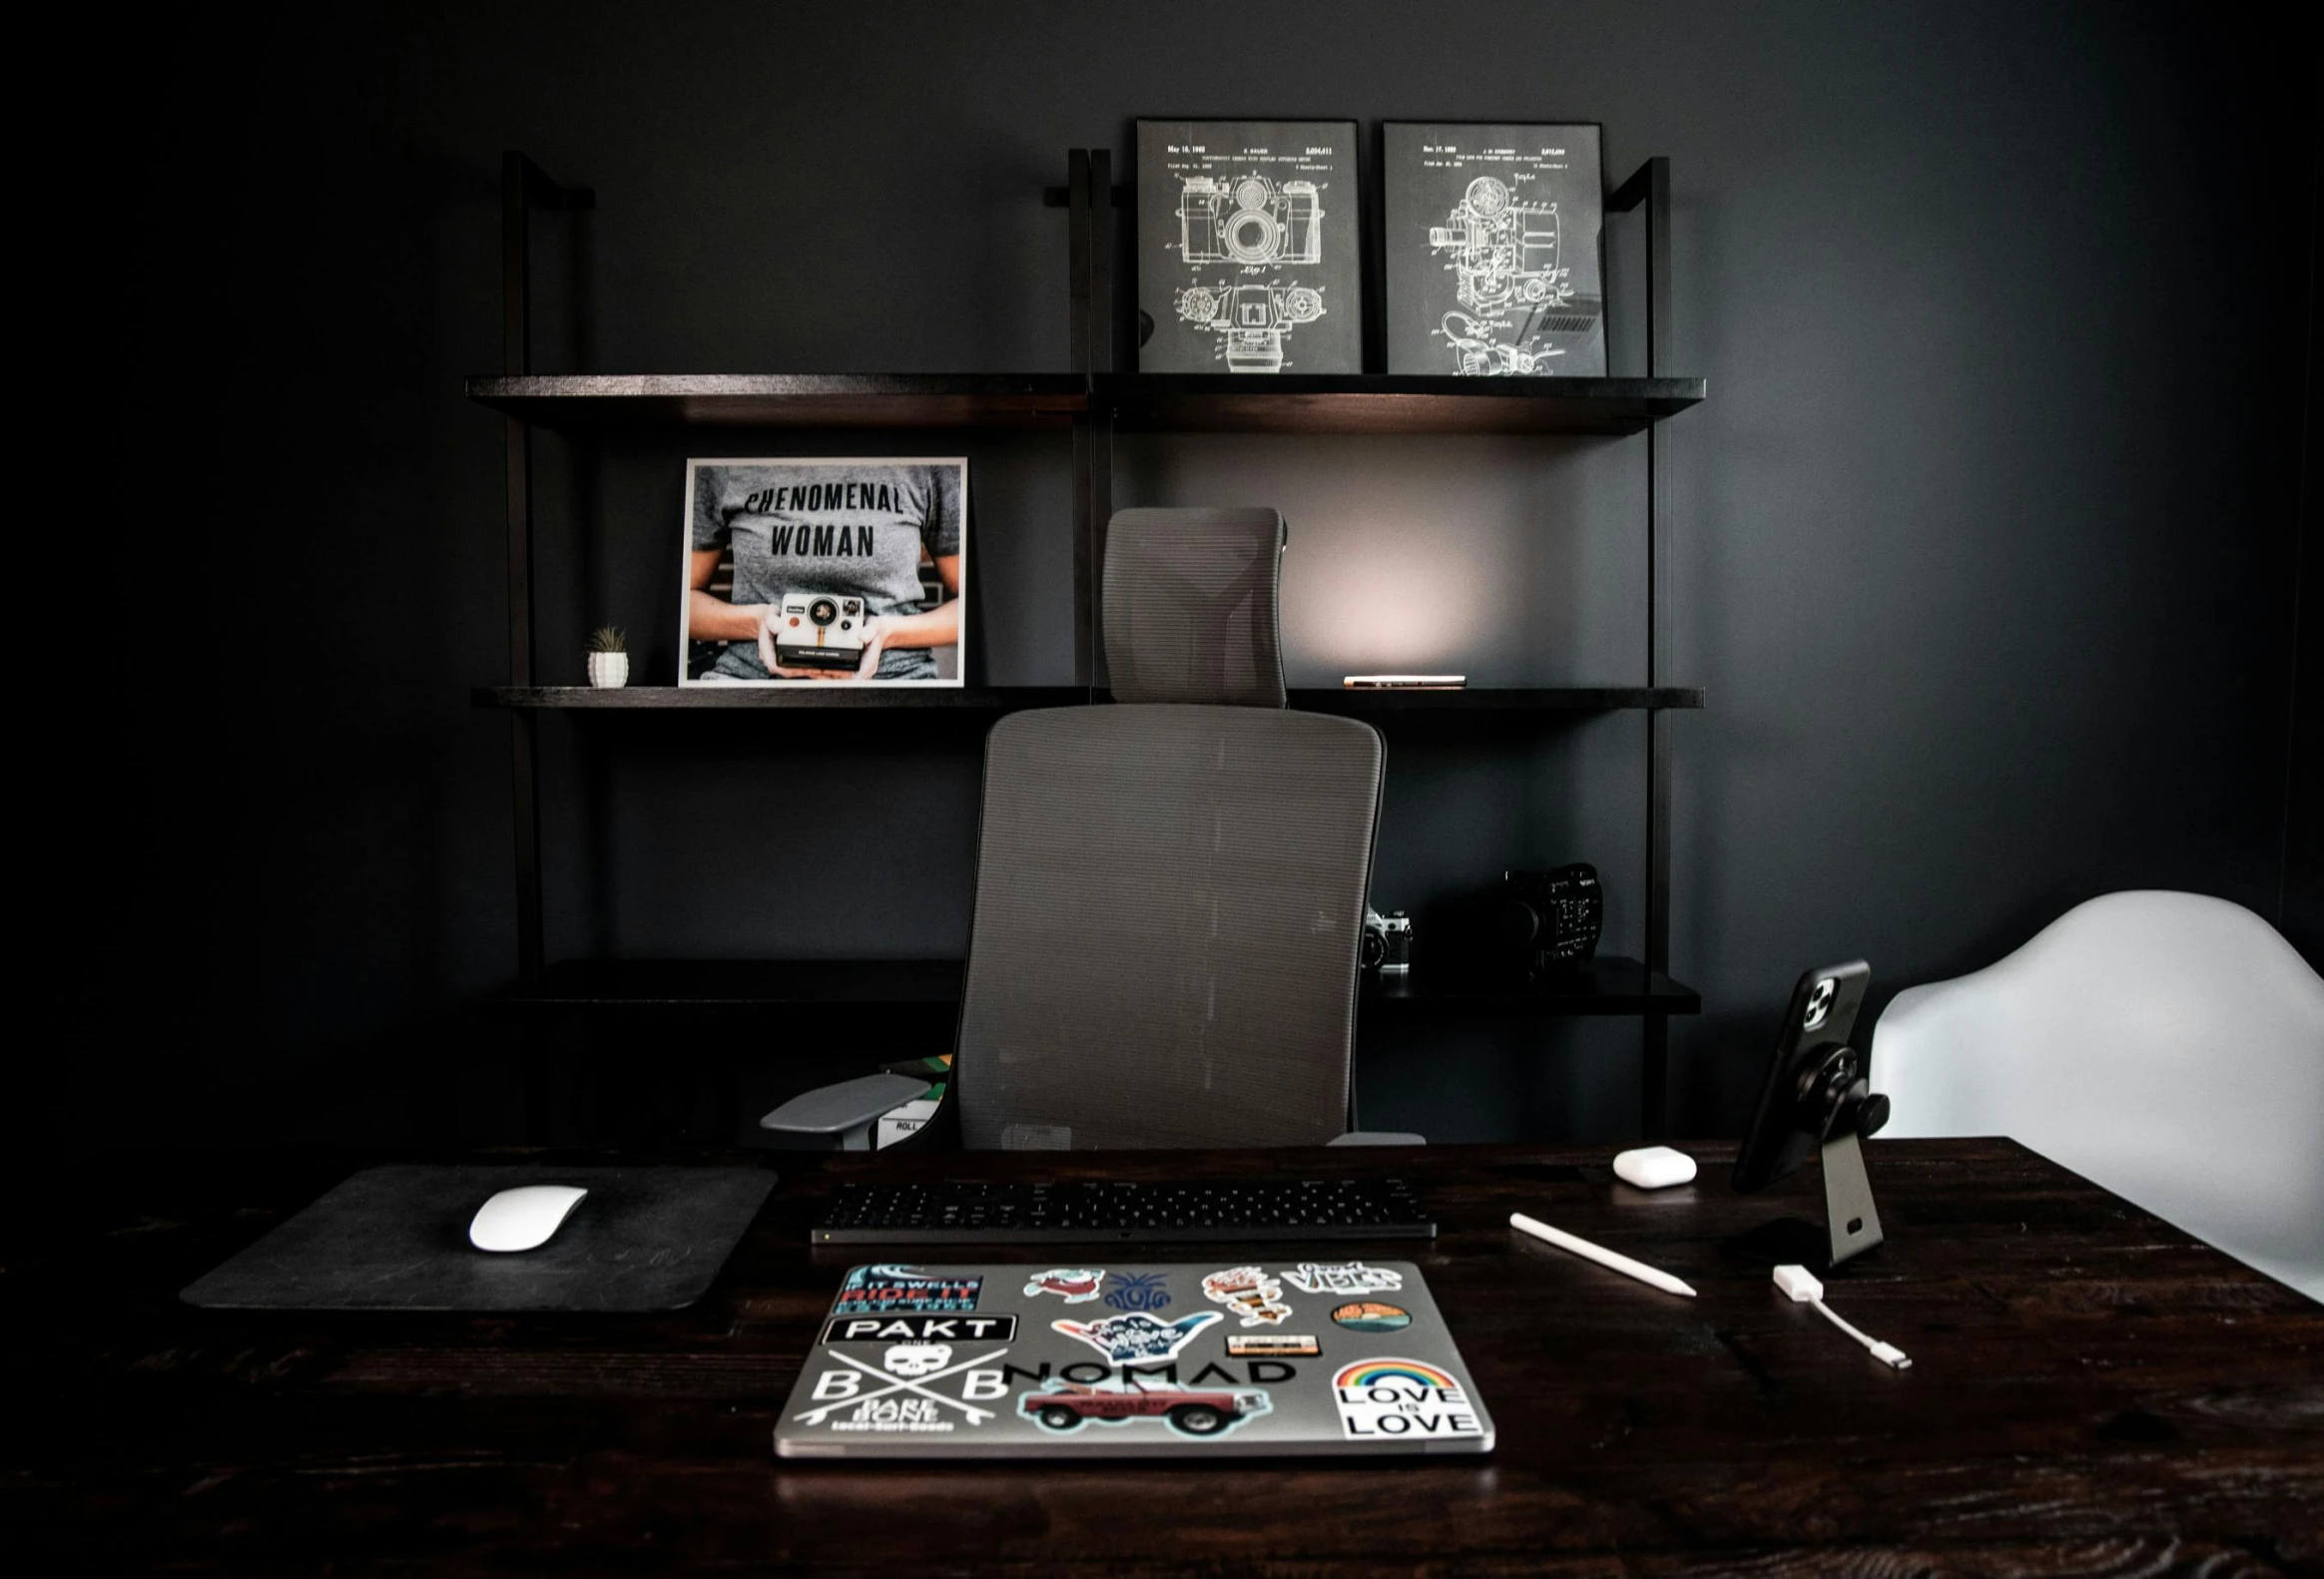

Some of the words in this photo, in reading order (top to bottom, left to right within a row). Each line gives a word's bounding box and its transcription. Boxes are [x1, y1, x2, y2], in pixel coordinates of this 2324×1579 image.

[744, 483, 903, 514] PHENOMENAL
[772, 525, 873, 557] WOMAN
[896, 1122, 917, 1131] ROLL
[868, 1281, 887, 1290] IT
[893, 1281, 979, 1290] SWELLS
[842, 1288, 930, 1302] RIDE
[940, 1288, 977, 1301] IT
[846, 1319, 996, 1338] PAKT
[1001, 1360, 1297, 1385] NOMAD
[812, 1370, 862, 1399] B
[961, 1369, 1009, 1399] B
[1339, 1387, 1465, 1404] LOVE
[852, 1408, 939, 1422] BONE
[1398, 1403, 1420, 1412] IS
[1347, 1413, 1478, 1434] LOVE
